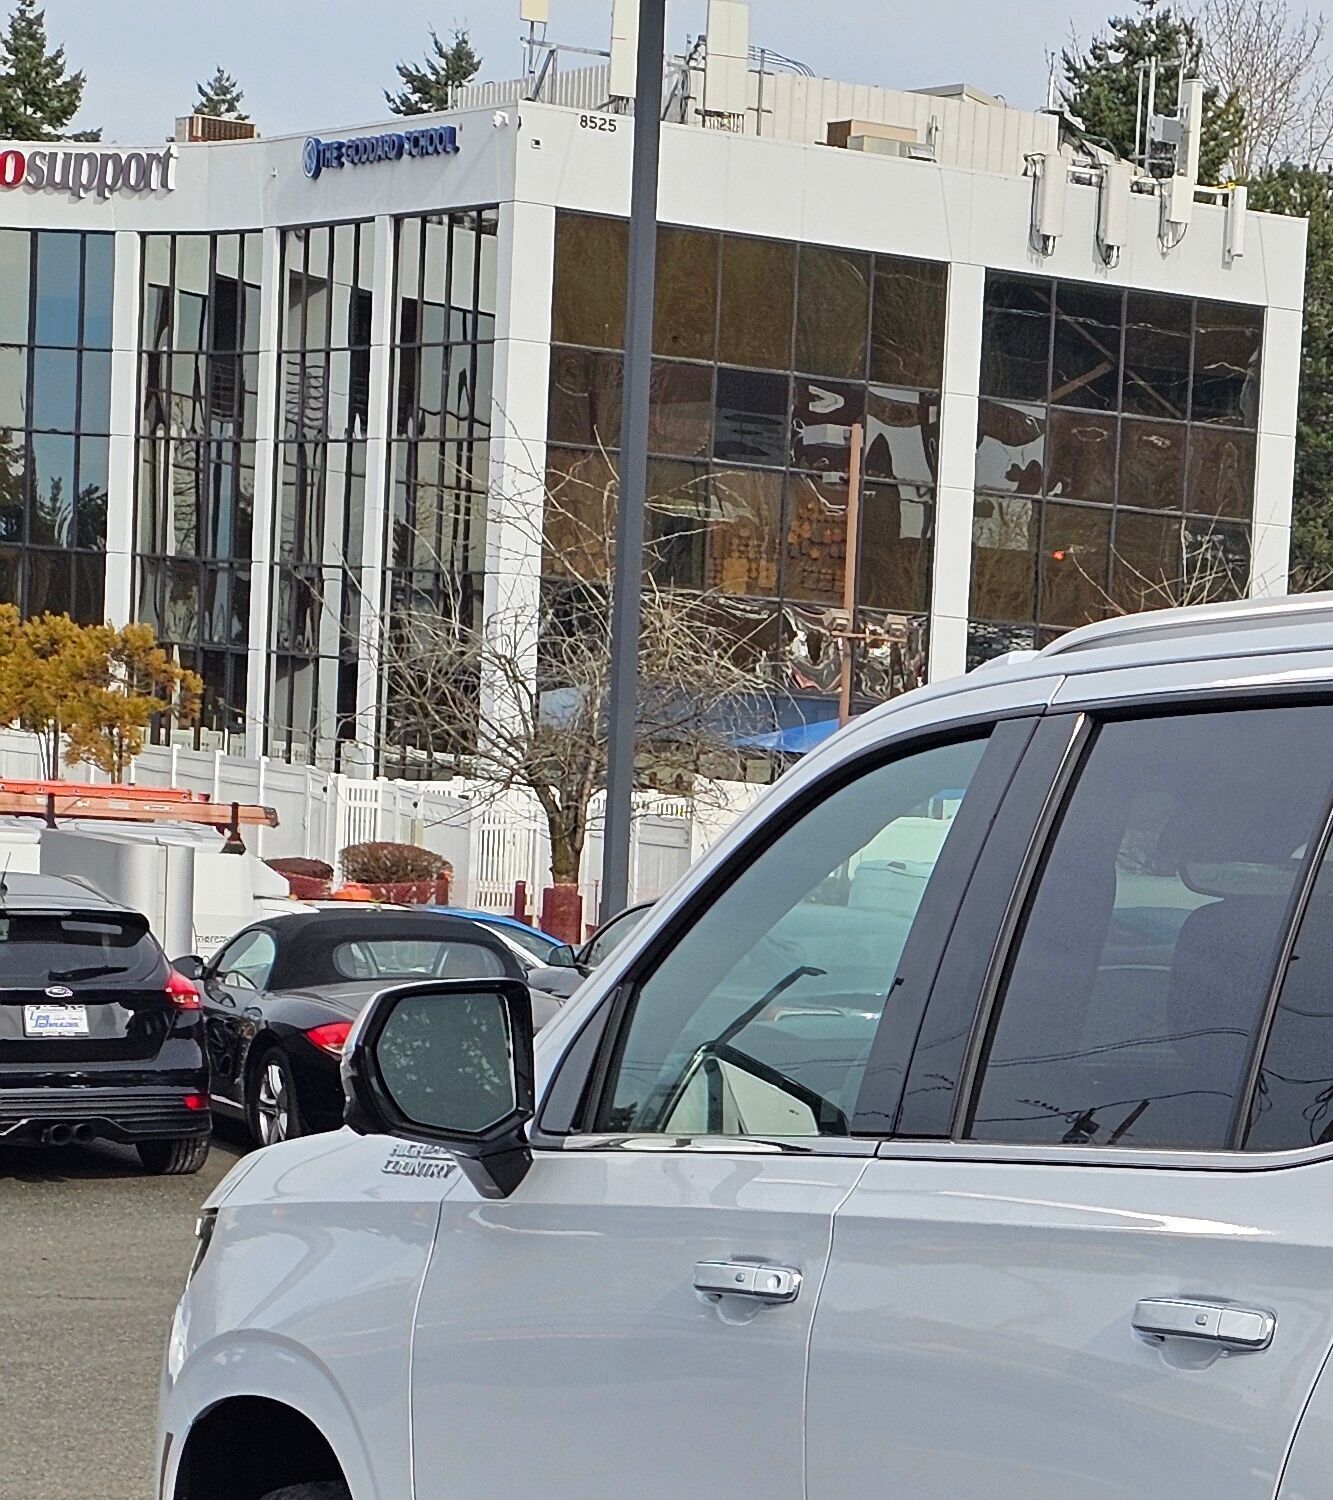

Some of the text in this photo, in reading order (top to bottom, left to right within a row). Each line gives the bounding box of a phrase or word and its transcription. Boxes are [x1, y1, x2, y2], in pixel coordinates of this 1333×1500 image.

[580, 115, 617, 132] 8525
[320, 126, 459, 168] THE GODDARD SCHOOL
[381, 1160, 457, 1178] COUNTRY
